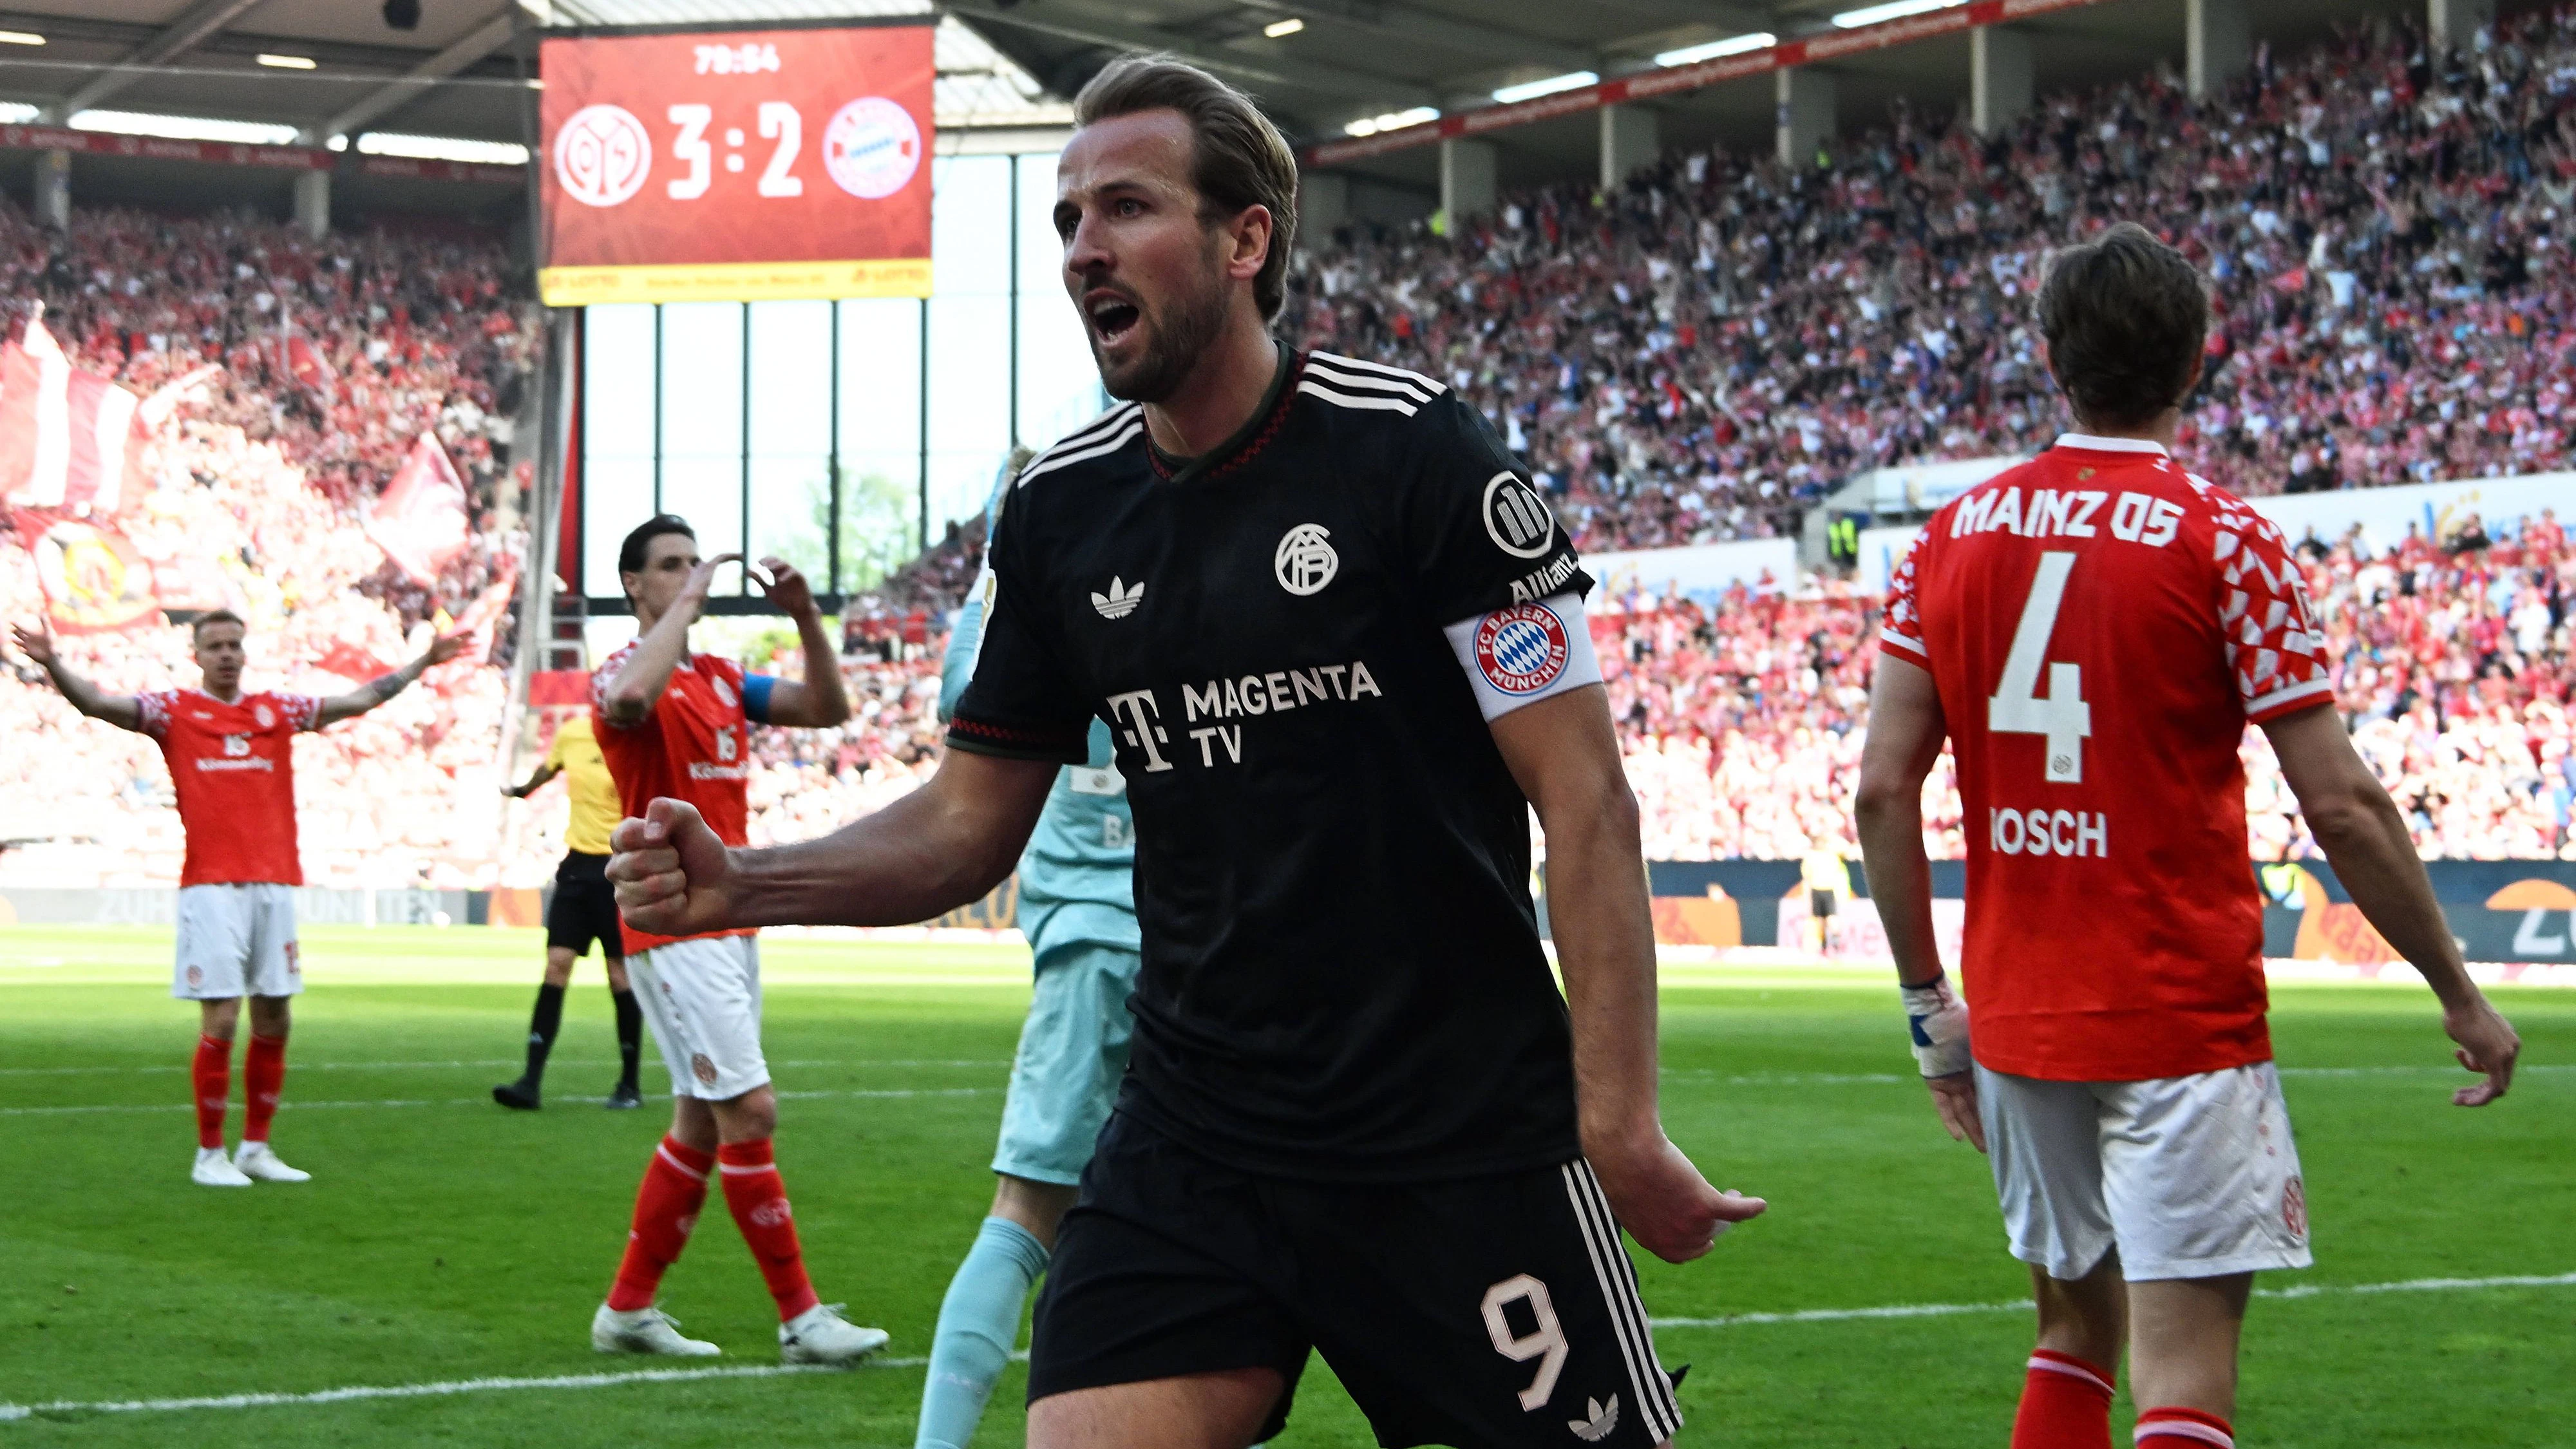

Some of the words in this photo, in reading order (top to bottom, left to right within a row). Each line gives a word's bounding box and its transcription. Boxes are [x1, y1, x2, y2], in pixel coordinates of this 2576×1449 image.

[1949, 486, 2110, 539] MAINZ
[2109, 491, 2186, 547] 05
[1509, 553, 1578, 605] Allianz
[1478, 632, 1492, 656] FC
[1486, 606, 1557, 631] BAYERN
[1181, 660, 1383, 723] MAGENTA
[1988, 550, 2092, 783] 4
[1189, 723, 1242, 768] TV
[1481, 1273, 1569, 1412] 9
